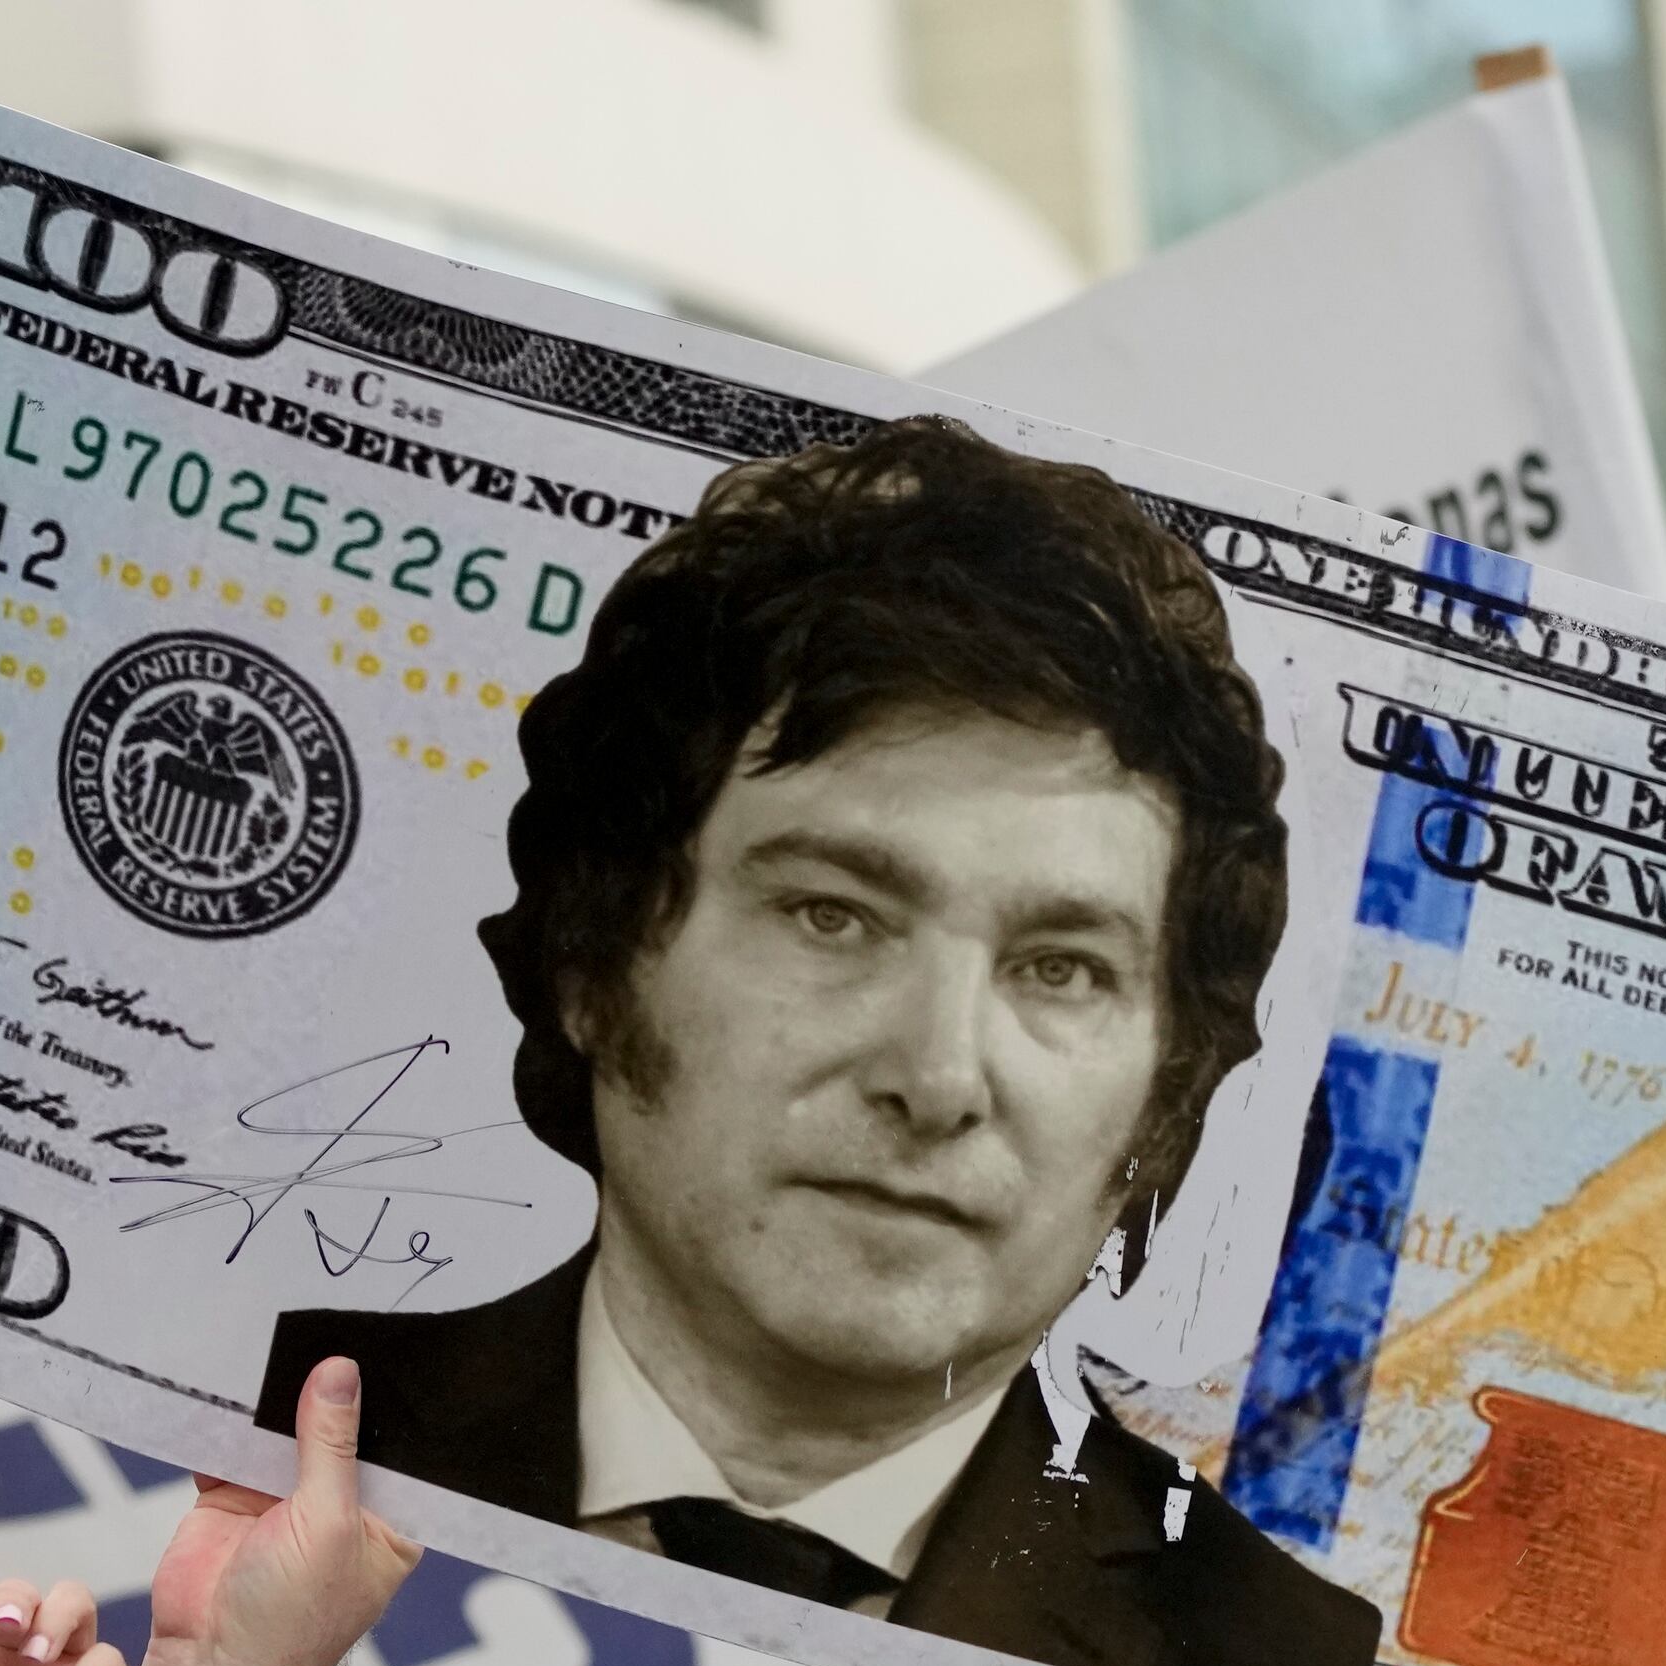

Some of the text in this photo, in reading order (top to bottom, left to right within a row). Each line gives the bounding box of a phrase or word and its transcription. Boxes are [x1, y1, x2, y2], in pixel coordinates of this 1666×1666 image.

[221, 381, 518, 503] RESERVE
[116, 651, 331, 762] UNITED STATES
[74, 712, 339, 922] FEDERAL RESERVE SYSTEM
[1415, 801, 1579, 909] OF
[1496, 947, 1555, 980] FOR
[1559, 965, 1614, 1001] ALL
[1566, 937, 1630, 977] THIS
[3, 1015, 33, 1050] the
